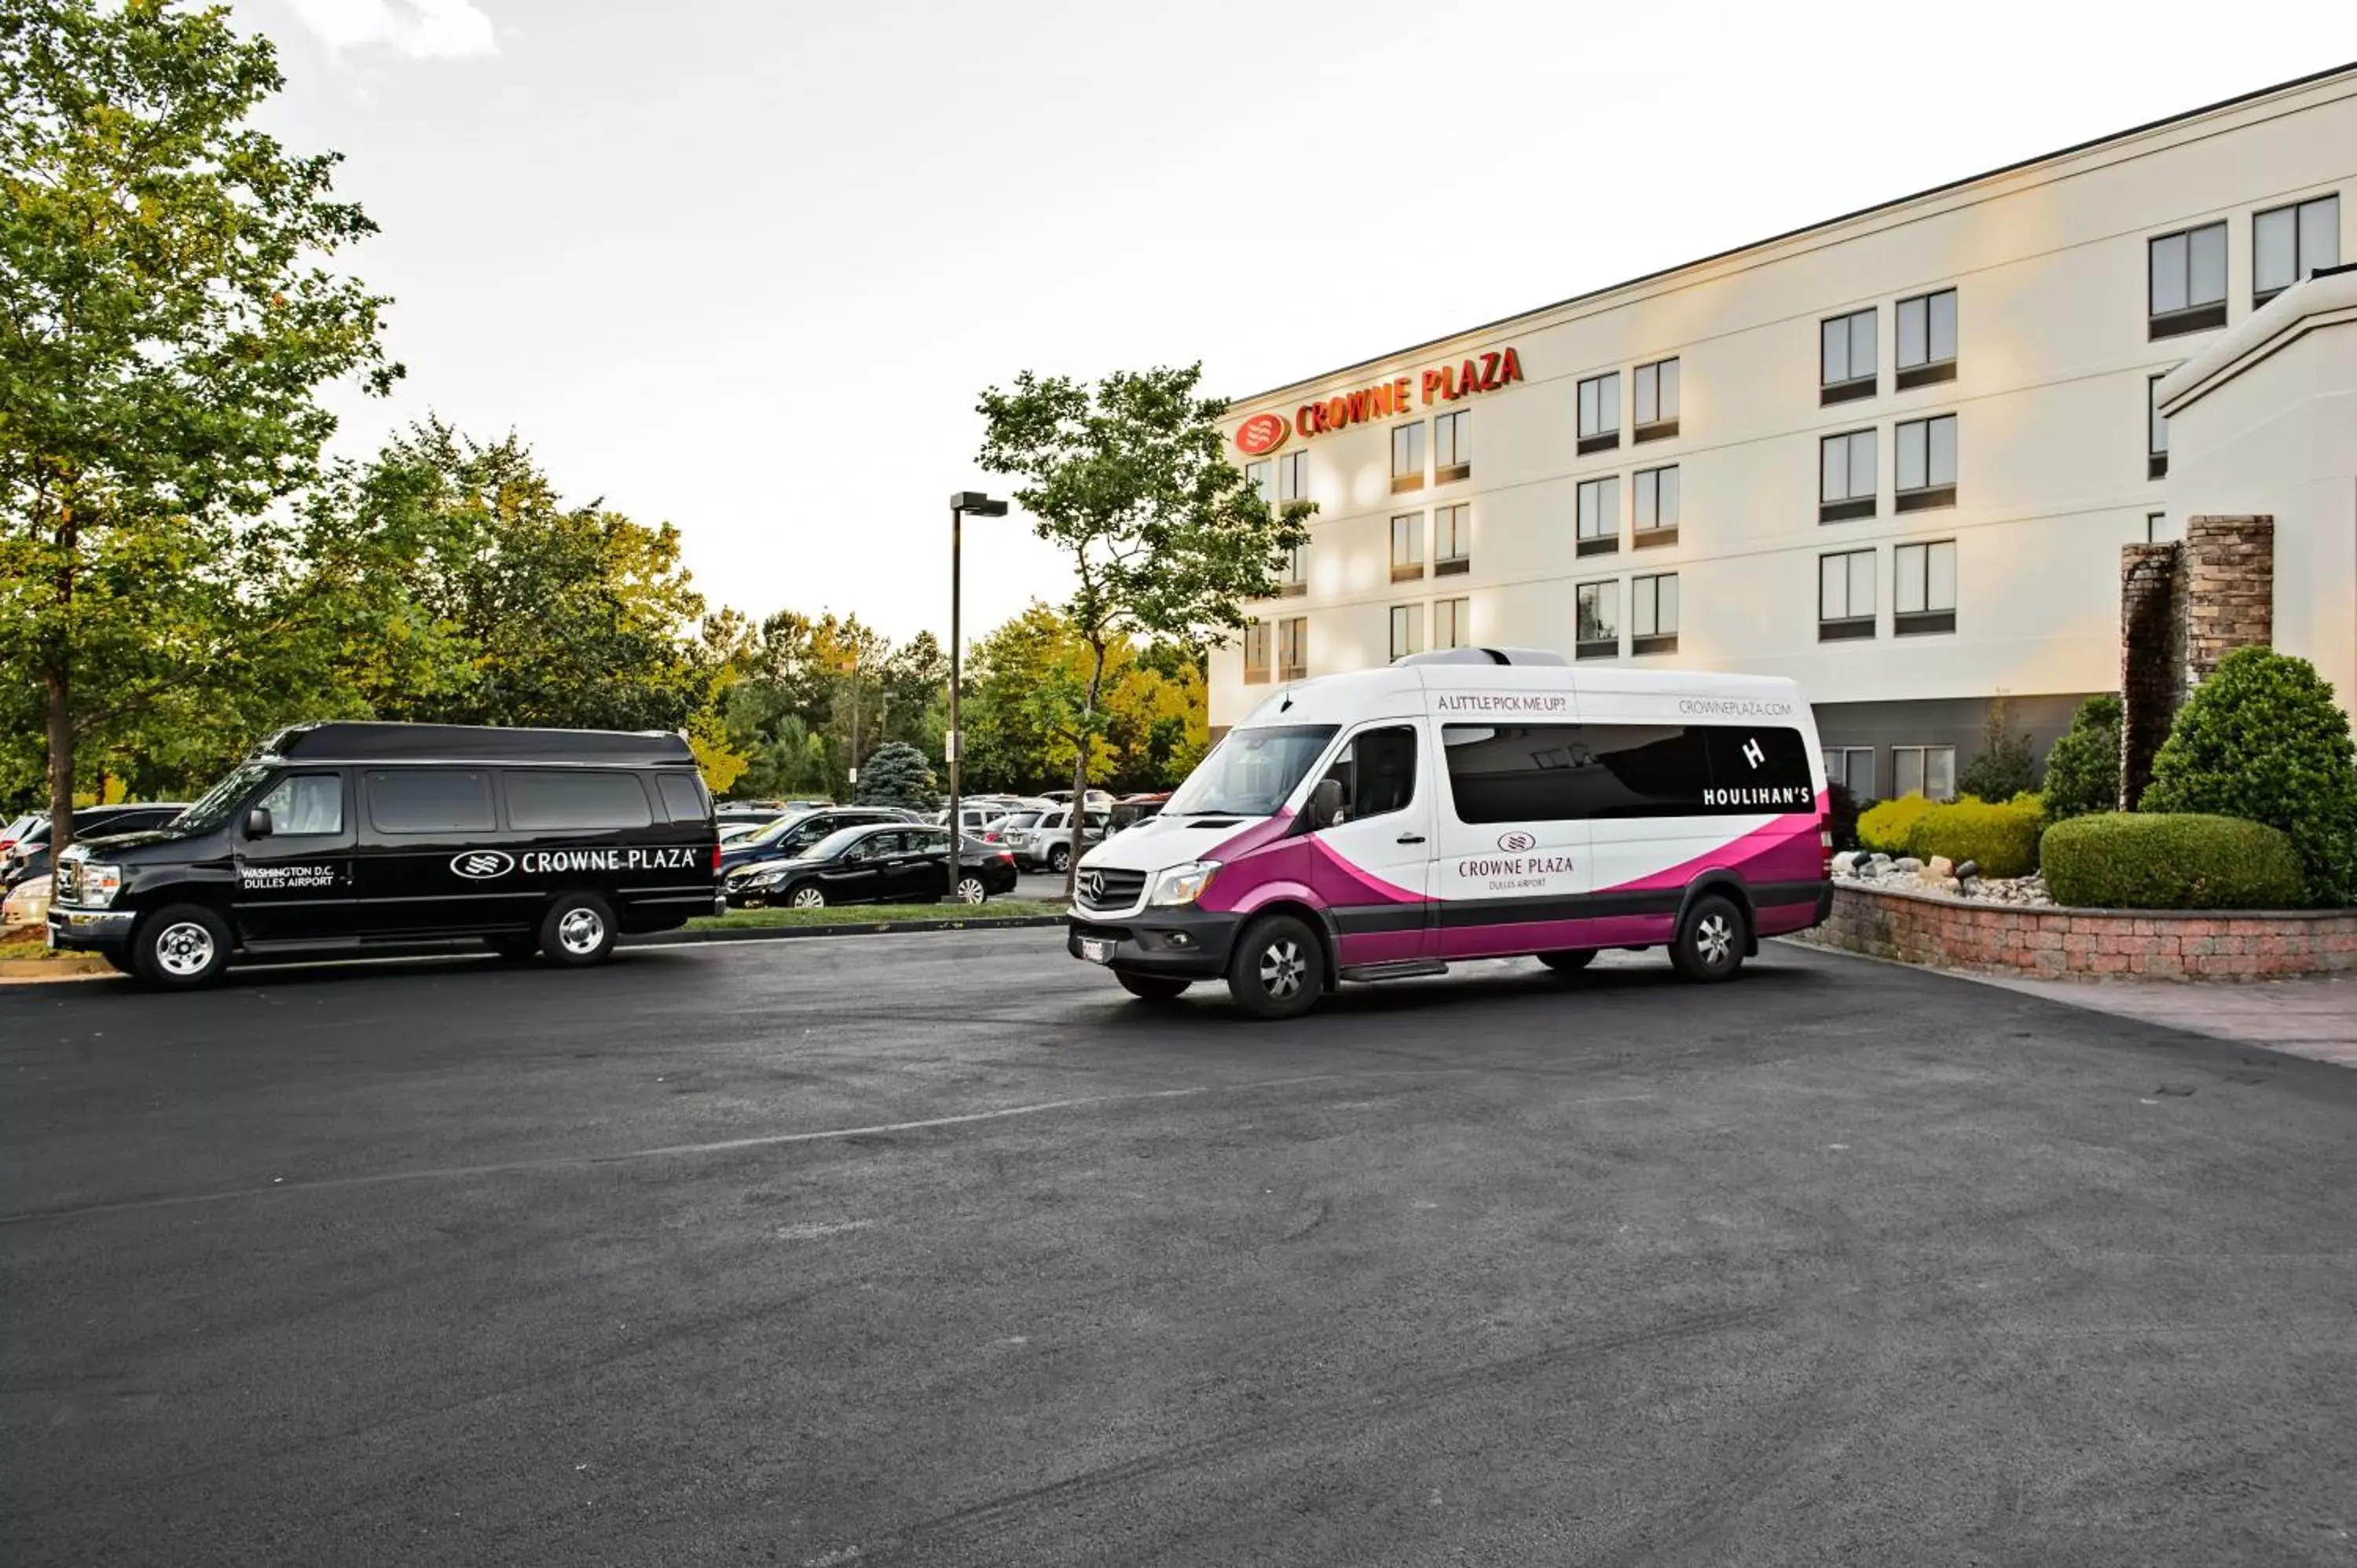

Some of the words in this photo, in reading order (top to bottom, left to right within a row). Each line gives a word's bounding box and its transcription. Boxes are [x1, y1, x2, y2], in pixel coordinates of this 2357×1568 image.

[1296, 377, 1411, 438] CROWNE
[1422, 346, 1523, 406] PLAZA
[1439, 695, 1448, 709] A
[1450, 696, 1492, 710] LITTLE
[1494, 697, 1521, 711] PICK
[1523, 697, 1543, 711] ME
[1545, 698, 1566, 711] UP?
[1679, 700, 1792, 716] CROWNEPLAZA.COM
[1742, 737, 1765, 769] H
[1703, 787, 1809, 805] HOULIHAN'S
[522, 850, 620, 873] CROWNE
[629, 848, 696, 870] PLAZA
[1459, 859, 1522, 877] CROWNE
[1528, 857, 1574, 874] PLAZA
[241, 866, 312, 878] WASHINGTON
[314, 866, 335, 876] D.C.
[244, 877, 285, 889] DULLES
[287, 876, 334, 887] AIRPORT
